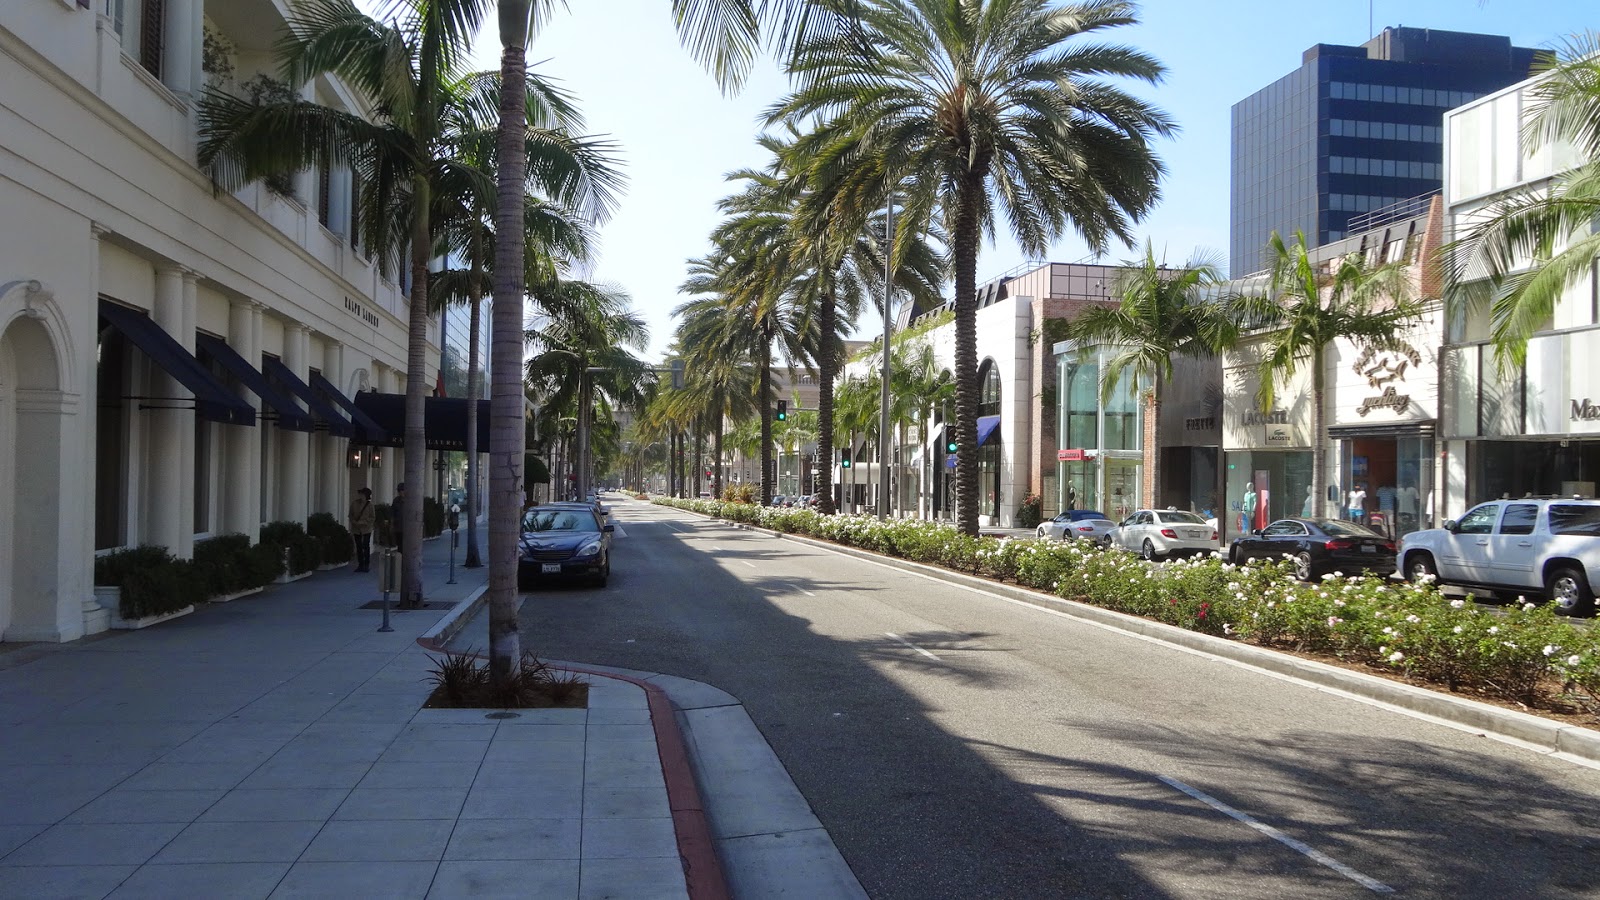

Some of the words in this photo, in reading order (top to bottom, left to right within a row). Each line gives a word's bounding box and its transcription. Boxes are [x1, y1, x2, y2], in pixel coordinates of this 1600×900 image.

[344, 296, 360, 316] RALPH
[362, 308, 379, 328] LAUREN
[1242, 410, 1287, 426] LACOSTE
[1232, 500, 1247, 511] SALE
